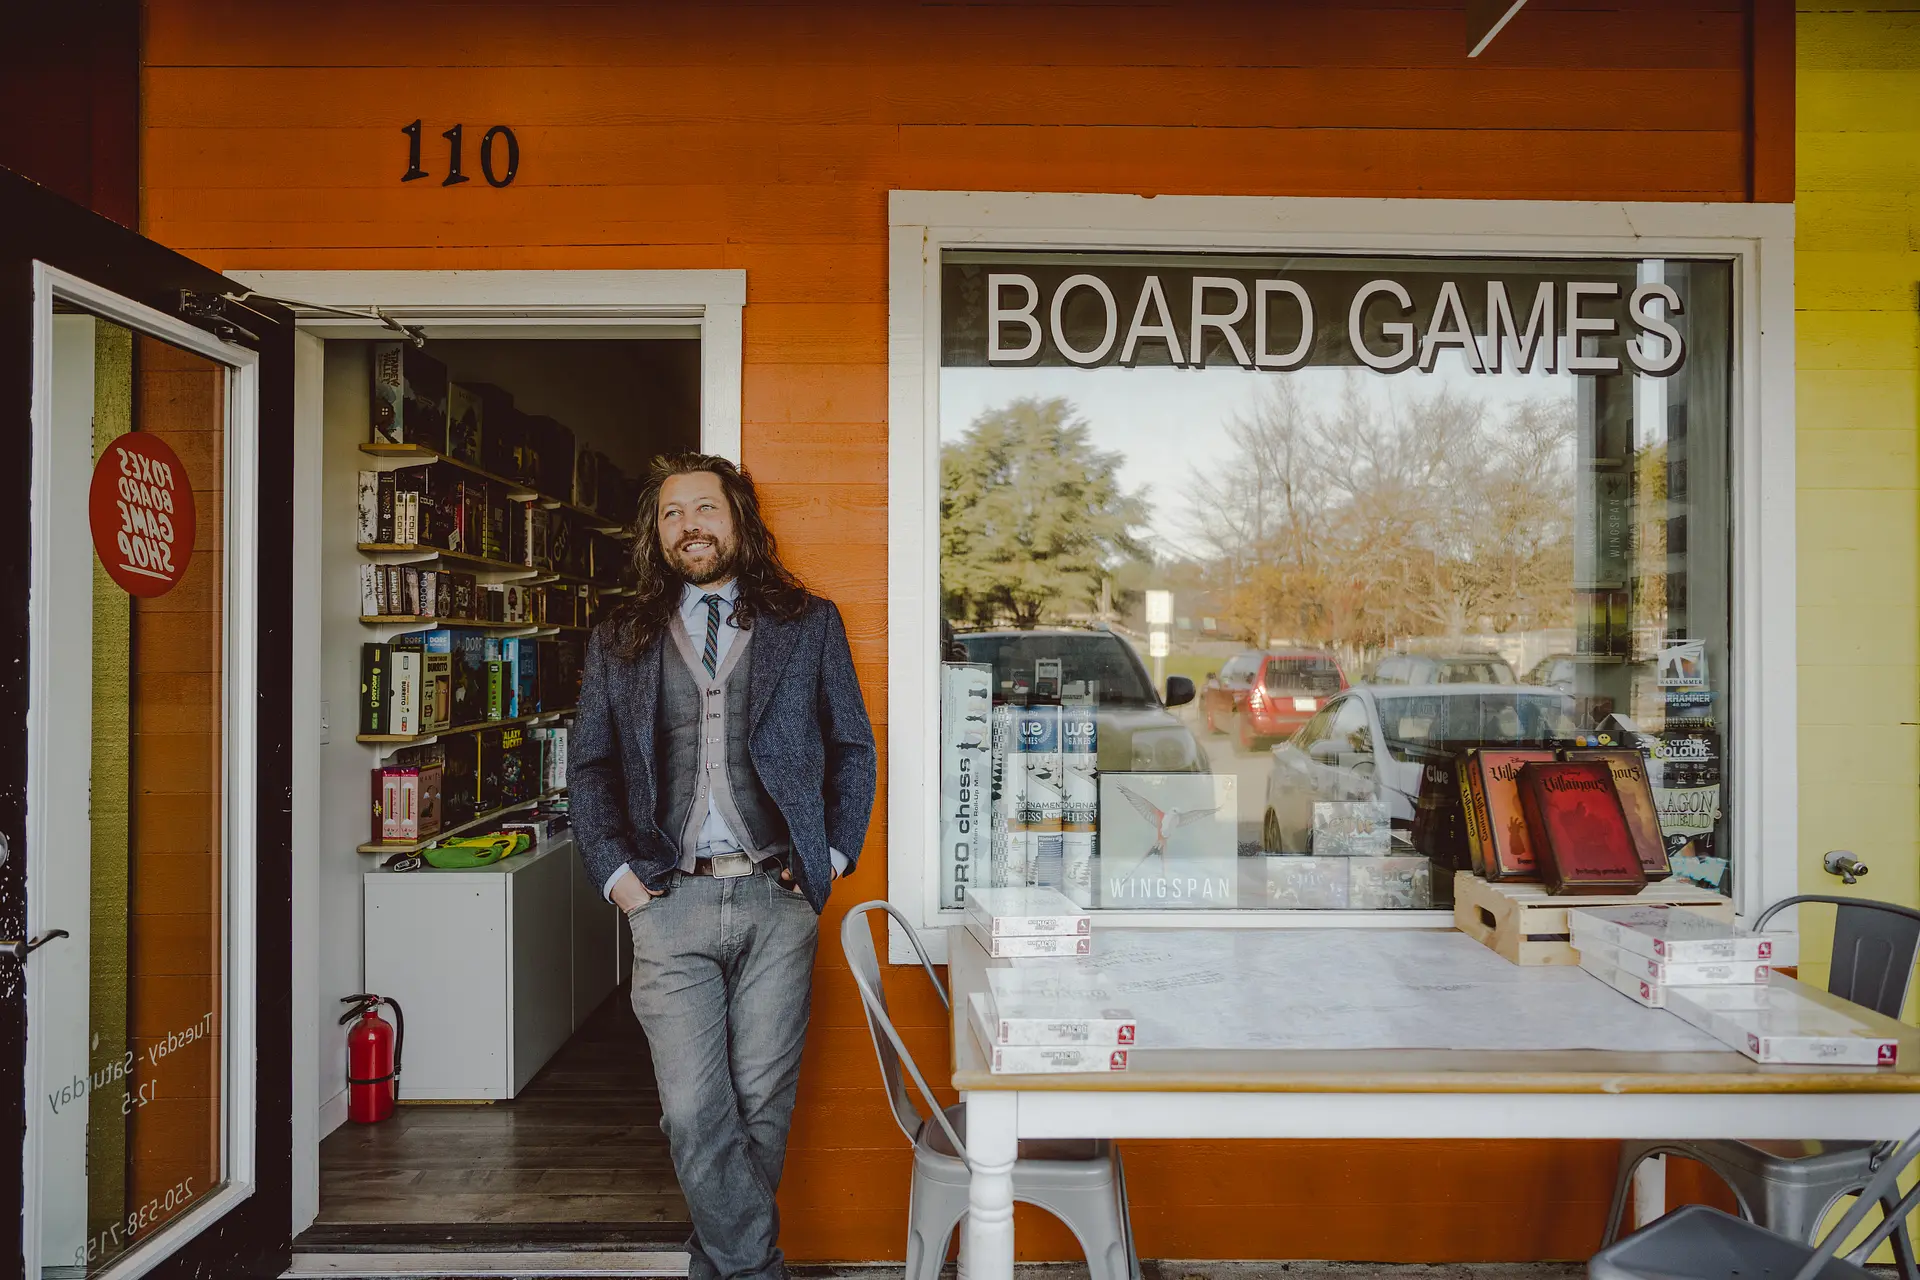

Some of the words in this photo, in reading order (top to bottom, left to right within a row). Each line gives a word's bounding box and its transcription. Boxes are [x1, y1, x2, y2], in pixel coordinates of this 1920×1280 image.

[401, 119, 519, 188] 110
[988, 273, 1316, 368] BOARD
[1348, 279, 1685, 374] GAMES
[1609, 499, 1620, 558] WINGSPAN
[503, 729, 521, 740] ALAXY
[1655, 746, 1707, 758] COLOUR
[1426, 764, 1449, 784] Clue
[1543, 774, 1608, 793] Villainous
[955, 757, 971, 834] chess
[1656, 790, 1715, 813] RAGON
[1659, 813, 1711, 828] HIELD
[1110, 877, 1230, 899] WINGSPAN
